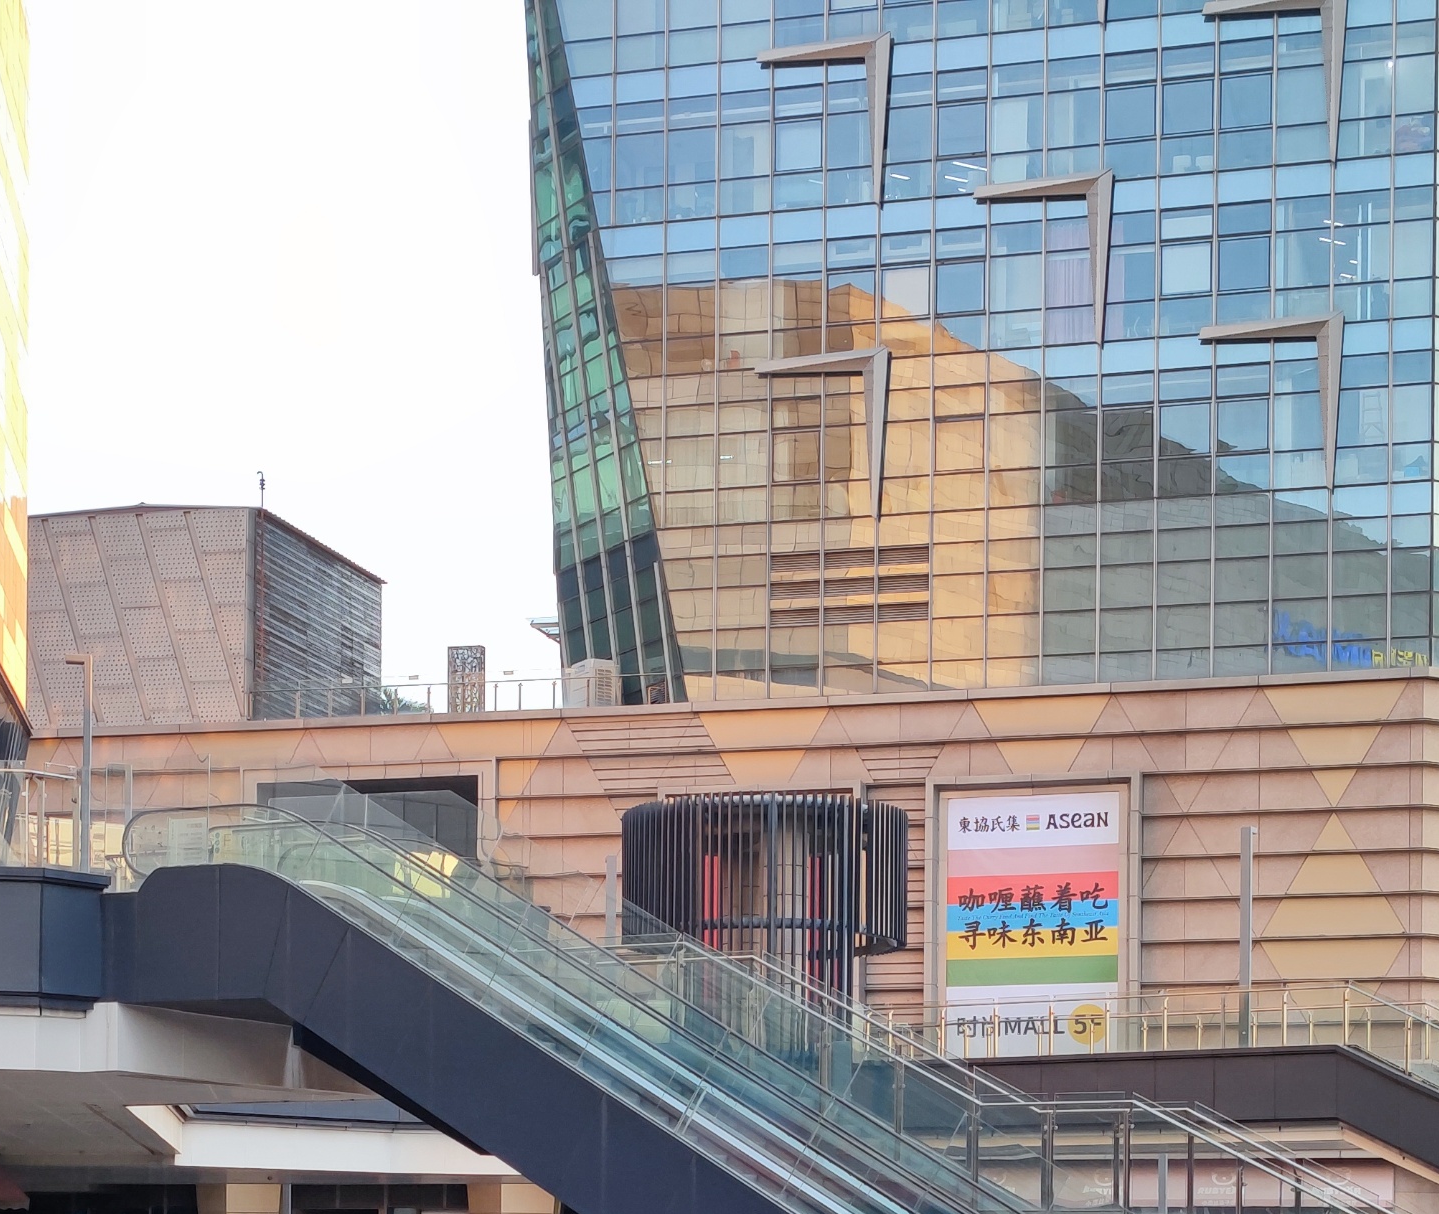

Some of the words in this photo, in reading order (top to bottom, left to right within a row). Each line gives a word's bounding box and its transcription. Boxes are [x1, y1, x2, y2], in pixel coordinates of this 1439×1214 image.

[957, 881, 1109, 914] 咖喱蘸着吃
[958, 918, 1109, 950] 寻味东南亚
